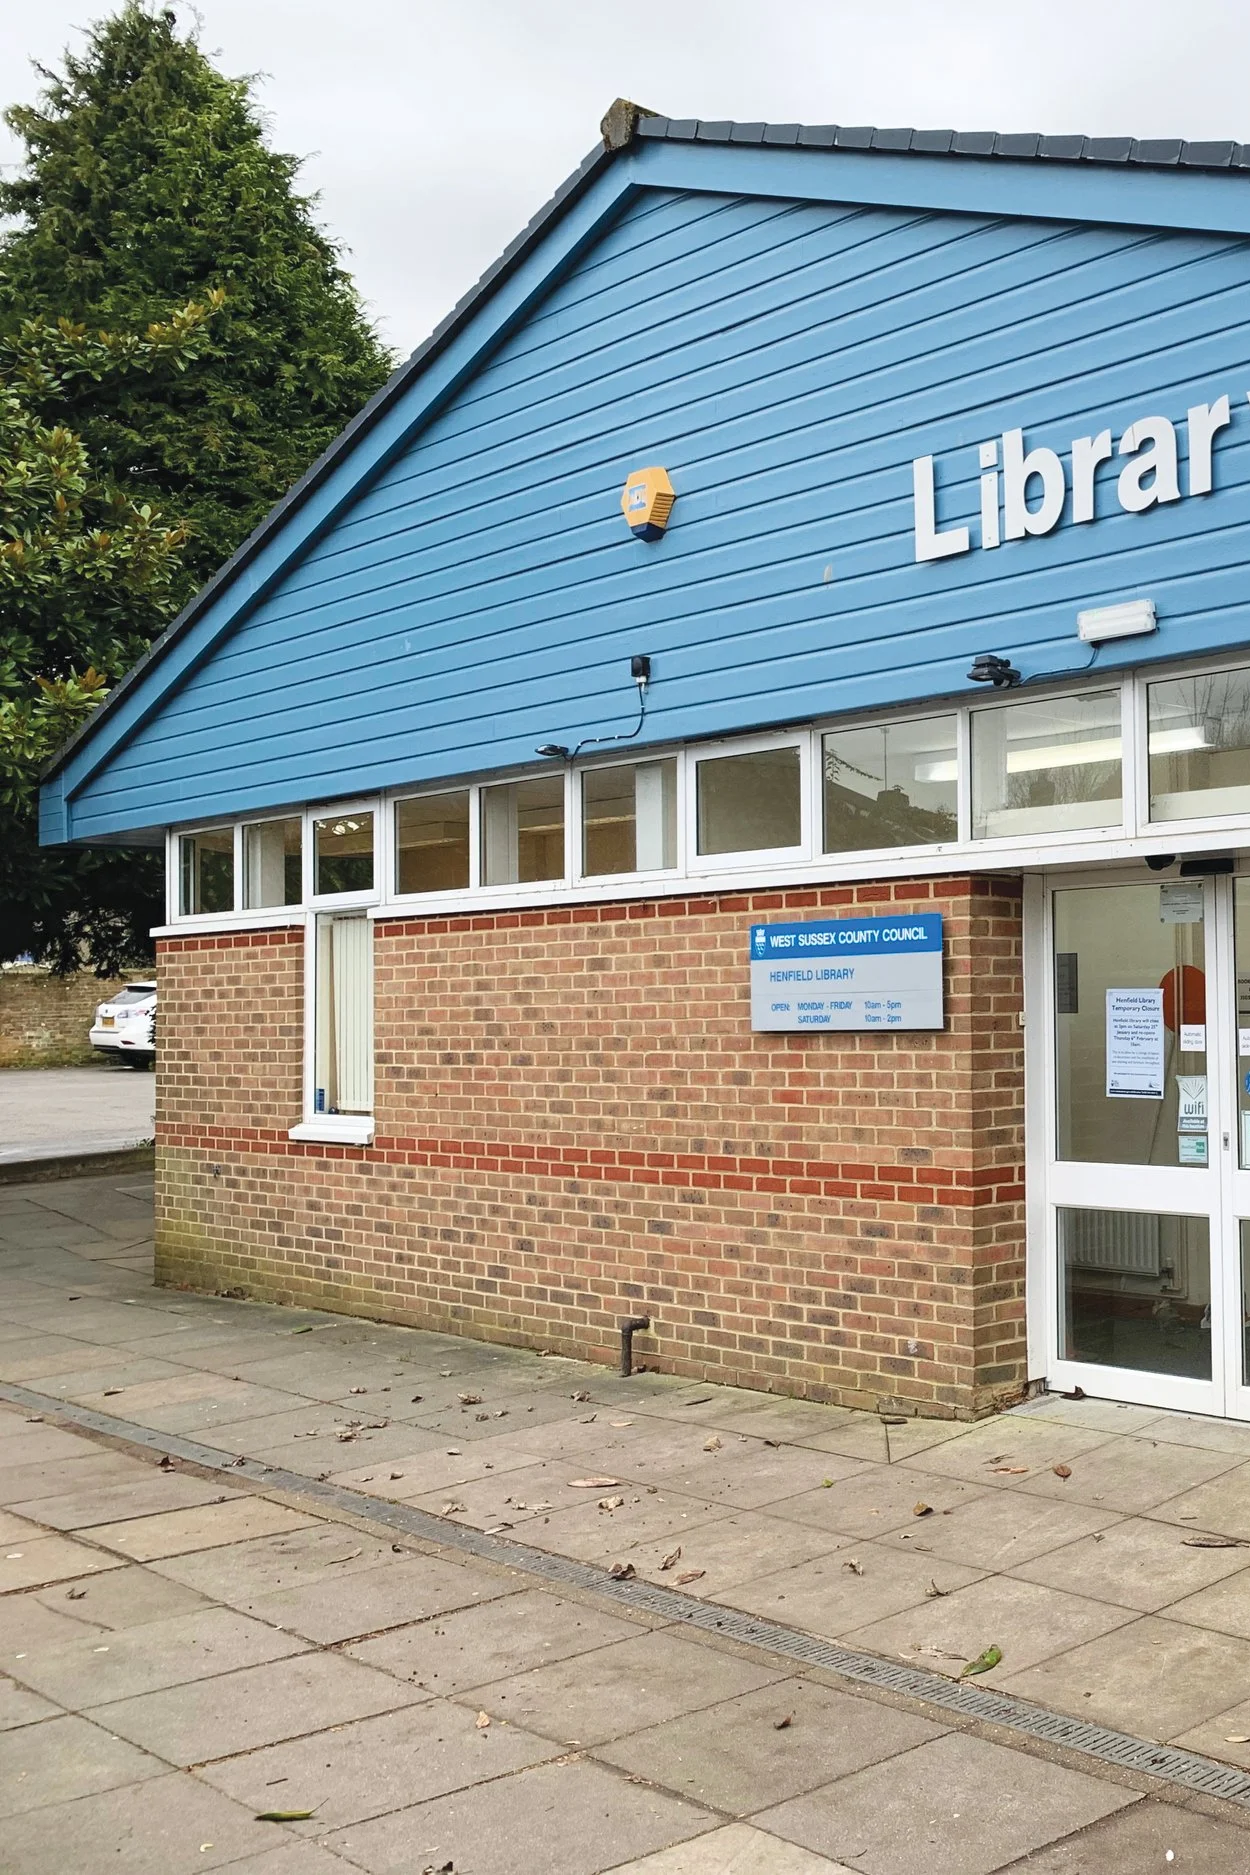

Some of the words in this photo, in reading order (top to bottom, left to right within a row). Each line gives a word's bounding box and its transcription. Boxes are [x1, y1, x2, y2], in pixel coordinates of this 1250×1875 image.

[770, 934, 796, 948] WEST
[798, 932, 836, 946] SUSSEX
[838, 930, 880, 944] COUNTY
[882, 926, 928, 942] COUNCIL
[770, 969, 814, 982] HENFIELD
[816, 968, 855, 981] LIBRARY
[771, 1003, 790, 1012] OPEN:
[798, 1002, 824, 1012] MONDAY
[830, 1001, 853, 1010] FRIDAY
[864, 1001, 882, 1010] 10am
[798, 1015, 831, 1024] SATURDAY
[886, 1014, 902, 1024] 2pm
[1184, 1102, 1204, 1115] wifi
